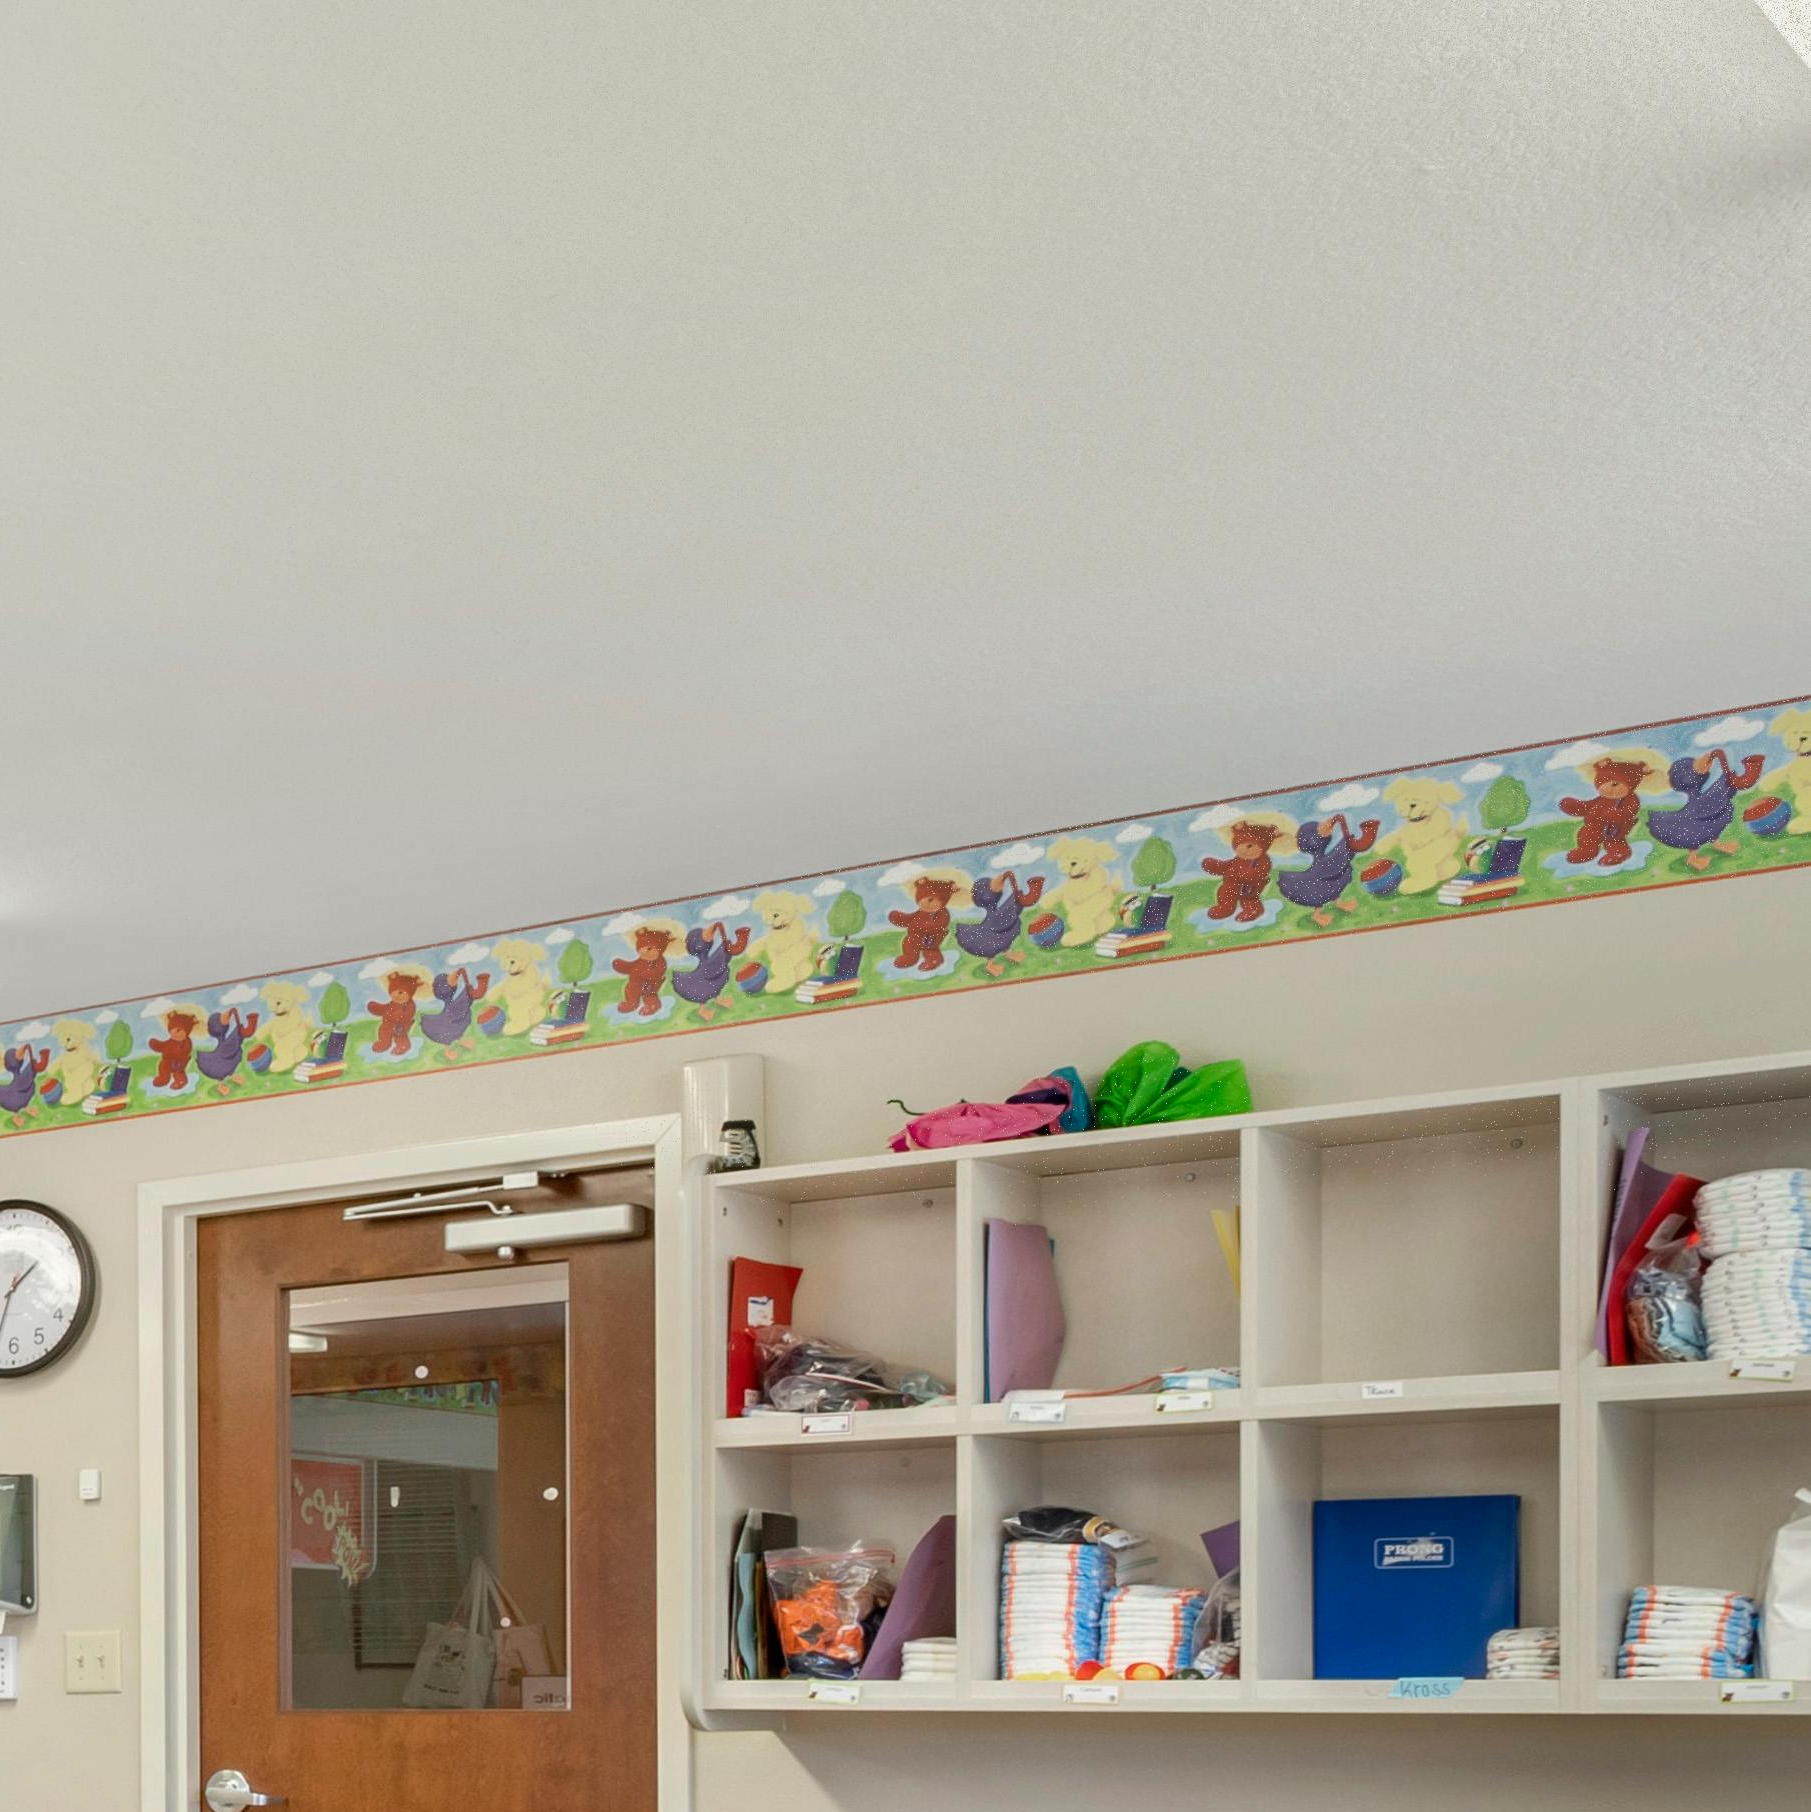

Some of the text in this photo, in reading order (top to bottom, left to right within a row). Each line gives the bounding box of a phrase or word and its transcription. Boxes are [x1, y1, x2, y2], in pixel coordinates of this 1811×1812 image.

[53, 1308, 64, 1322] 4
[34, 1328, 44, 1344] 5
[9, 1338, 19, 1354] 6
